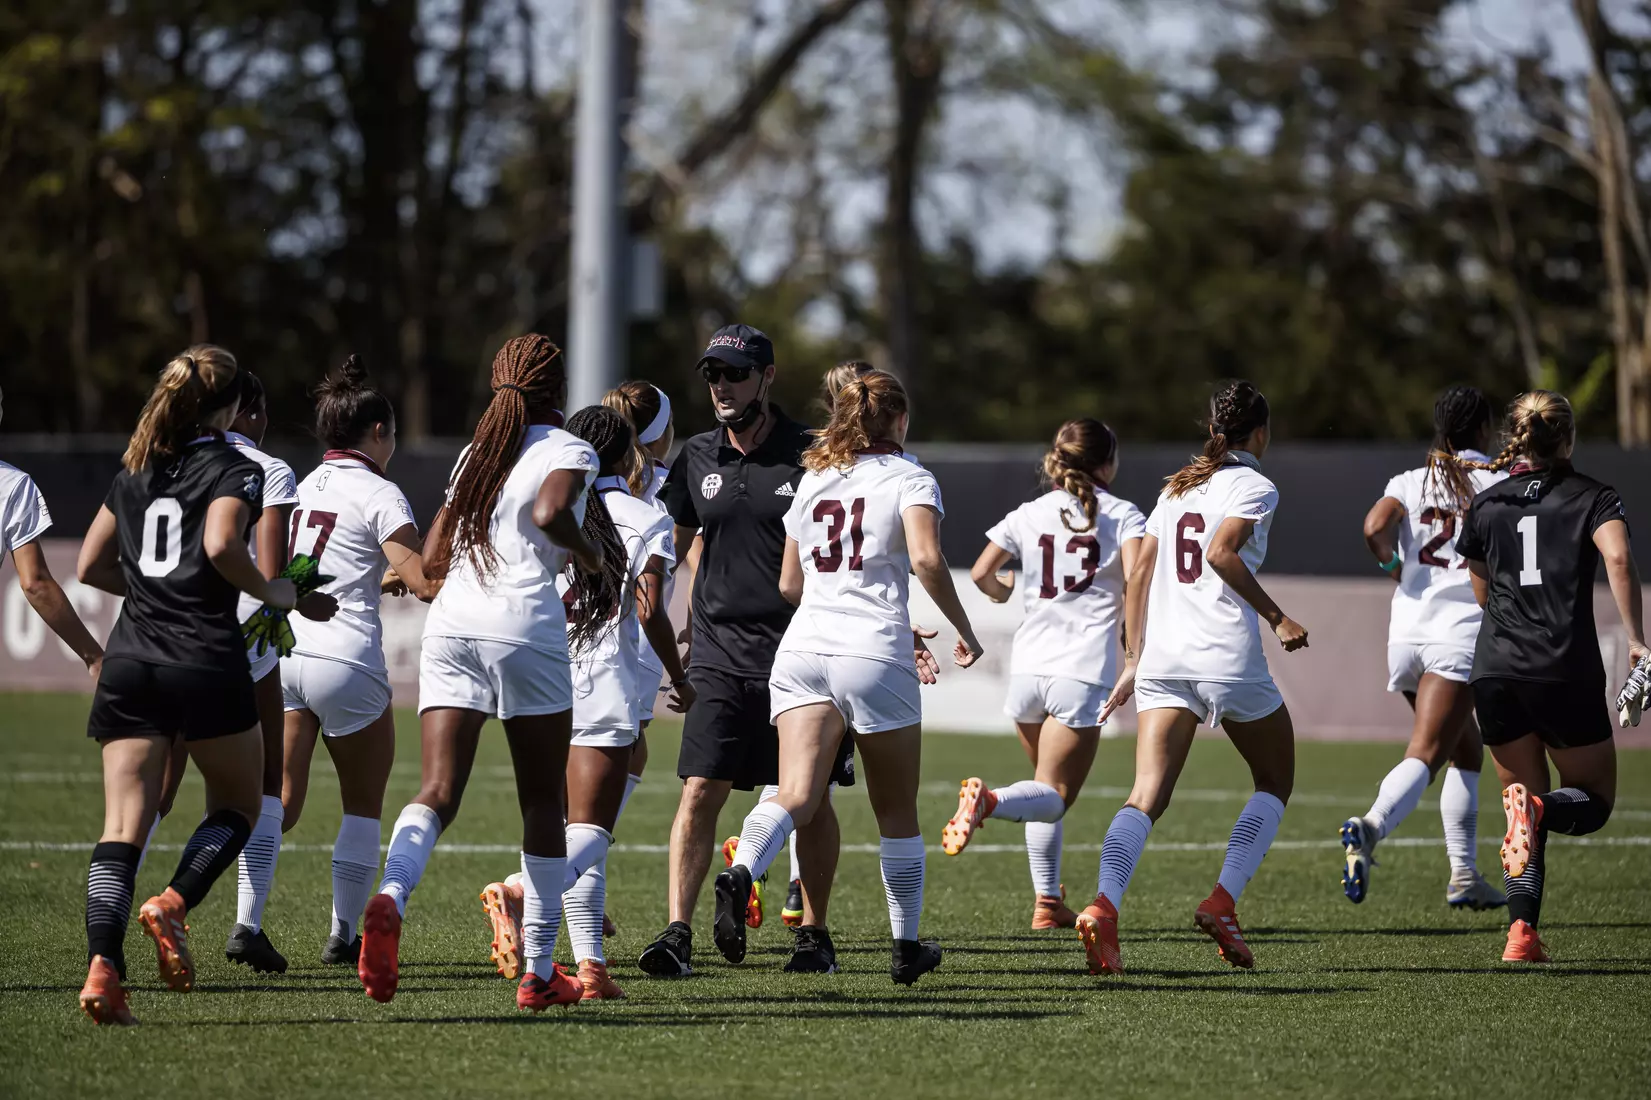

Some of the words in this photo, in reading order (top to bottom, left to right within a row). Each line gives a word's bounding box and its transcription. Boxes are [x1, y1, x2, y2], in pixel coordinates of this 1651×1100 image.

[707, 335, 746, 351] STATE
[138, 497, 183, 577] 0
[811, 497, 866, 572] 31
[1038, 534, 1101, 599] 13
[1176, 512, 1206, 584] 6
[1418, 507, 1469, 569] 2
[1517, 516, 1542, 586] 1
